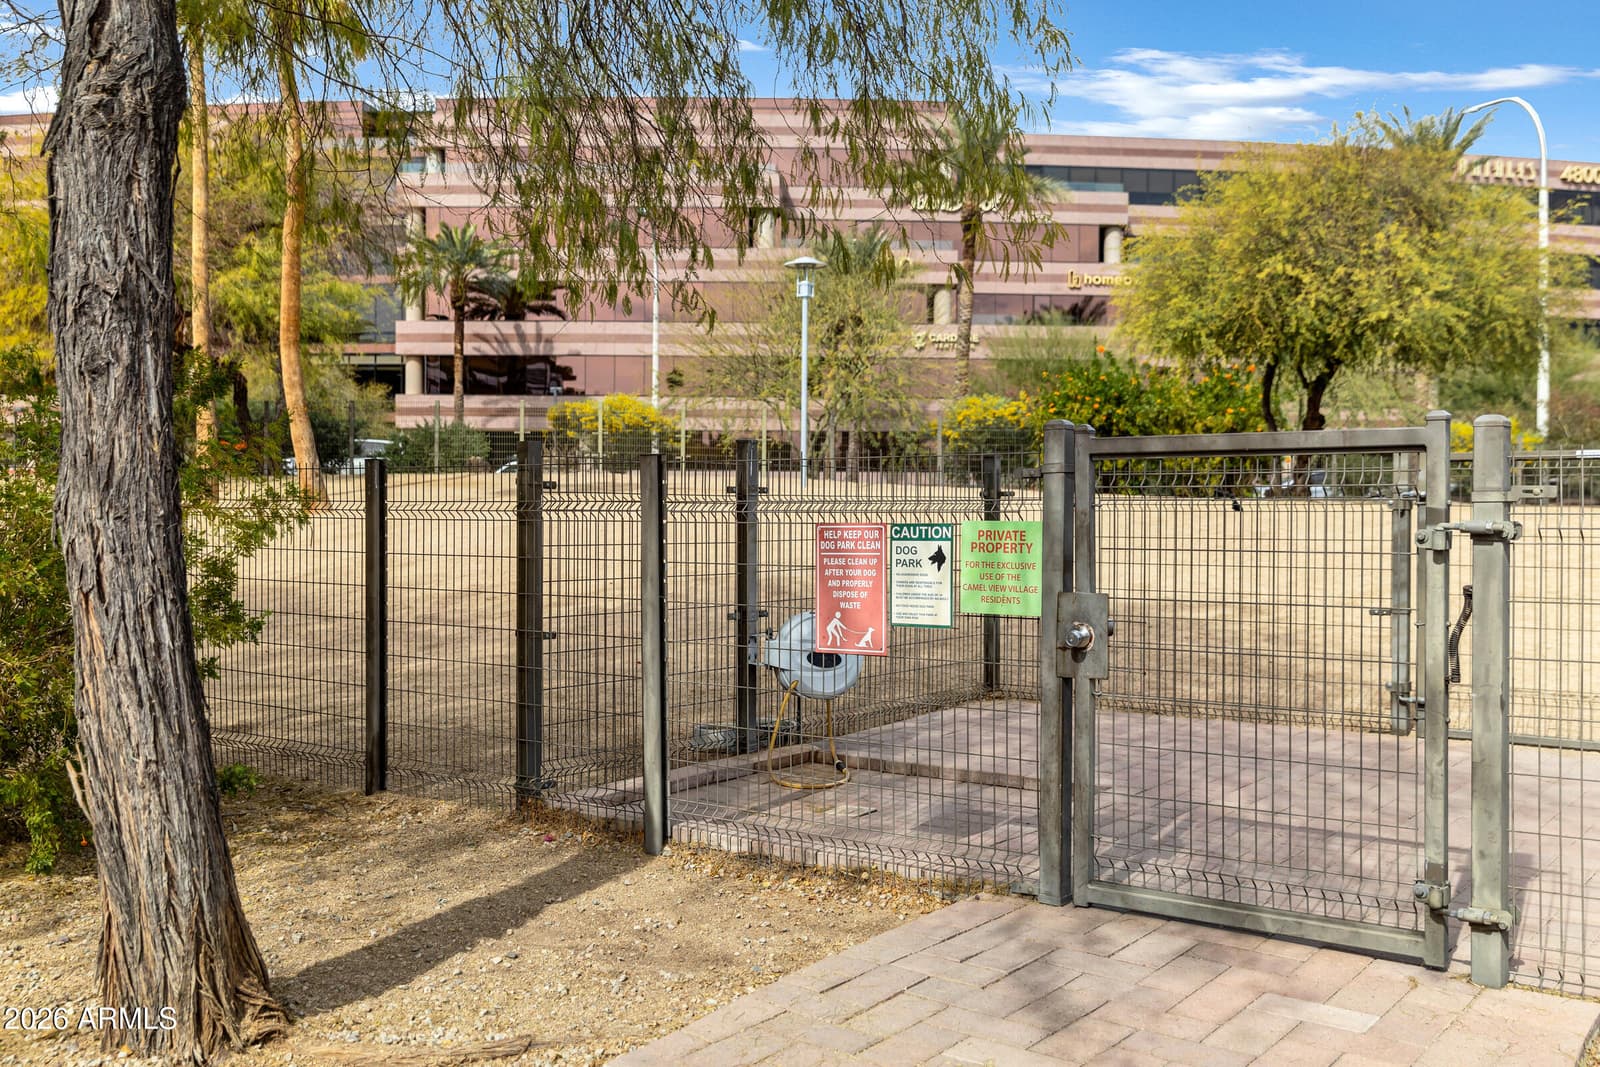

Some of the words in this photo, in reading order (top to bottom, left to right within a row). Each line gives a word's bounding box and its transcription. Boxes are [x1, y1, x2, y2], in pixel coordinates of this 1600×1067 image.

[824, 530, 841, 538] HELP
[844, 530, 862, 538] KEEP
[864, 530, 879, 538] OUR
[892, 526, 952, 538] CAUTION
[978, 530, 1026, 542] PRIVATE
[820, 541, 835, 549] DOG
[837, 541, 855, 549] PARK
[857, 541, 880, 550] CLEAN
[971, 542, 1032, 554] PROPERTY
[896, 546, 918, 555] DOG
[896, 559, 922, 568] PARK
[996, 562, 1036, 570] EXCLUSIVE
[981, 596, 1021, 604] RESIDENTS
